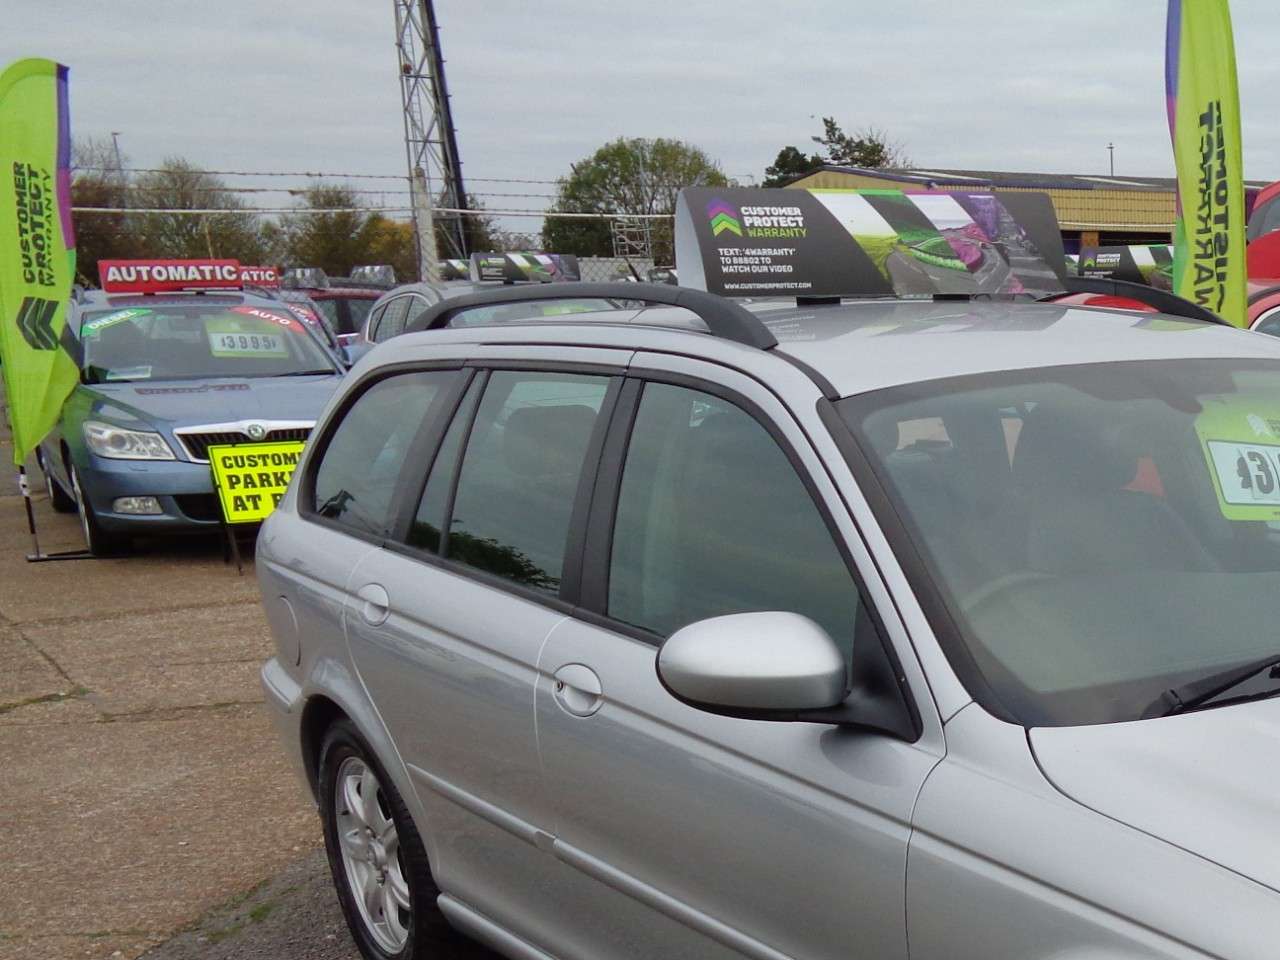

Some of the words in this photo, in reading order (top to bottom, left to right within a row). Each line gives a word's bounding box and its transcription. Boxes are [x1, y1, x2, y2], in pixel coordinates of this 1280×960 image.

[740, 206, 802, 216] CUSTOMER
[14, 161, 36, 284] CUSTOMER
[28, 163, 49, 285] PROTECT
[743, 216, 804, 227] PROTECT
[746, 228, 807, 238] WARRANTY
[718, 248, 742, 256] TEXT:
[106, 264, 238, 283] AUTOMATIC
[721, 265, 751, 273] WATCH
[751, 265, 769, 273] OUR
[769, 265, 793, 273] VIDEO
[248, 309, 291, 325] AUTO
[233, 494, 262, 512] AT
